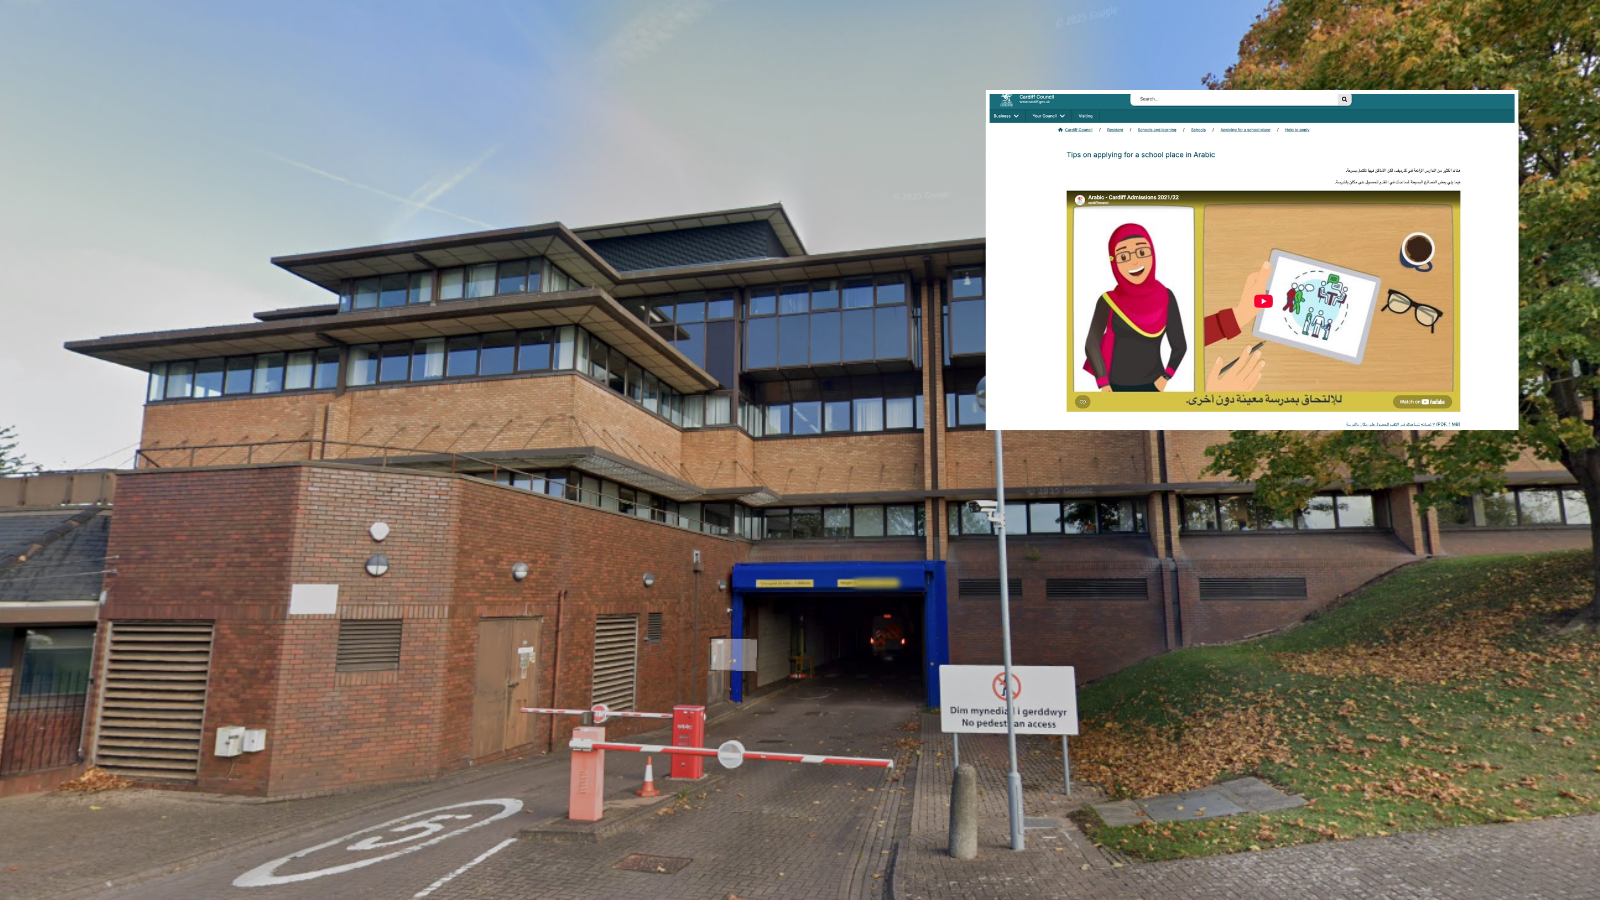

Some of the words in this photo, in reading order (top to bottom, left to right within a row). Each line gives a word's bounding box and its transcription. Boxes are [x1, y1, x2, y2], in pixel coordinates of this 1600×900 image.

[950, 706, 968, 714] Dim
[970, 707, 1016, 716] mynedia
[1022, 708, 1067, 718] gerddwyr
[962, 718, 974, 727] No
[976, 719, 1026, 729] pedestan
[1027, 720, 1057, 729] access
